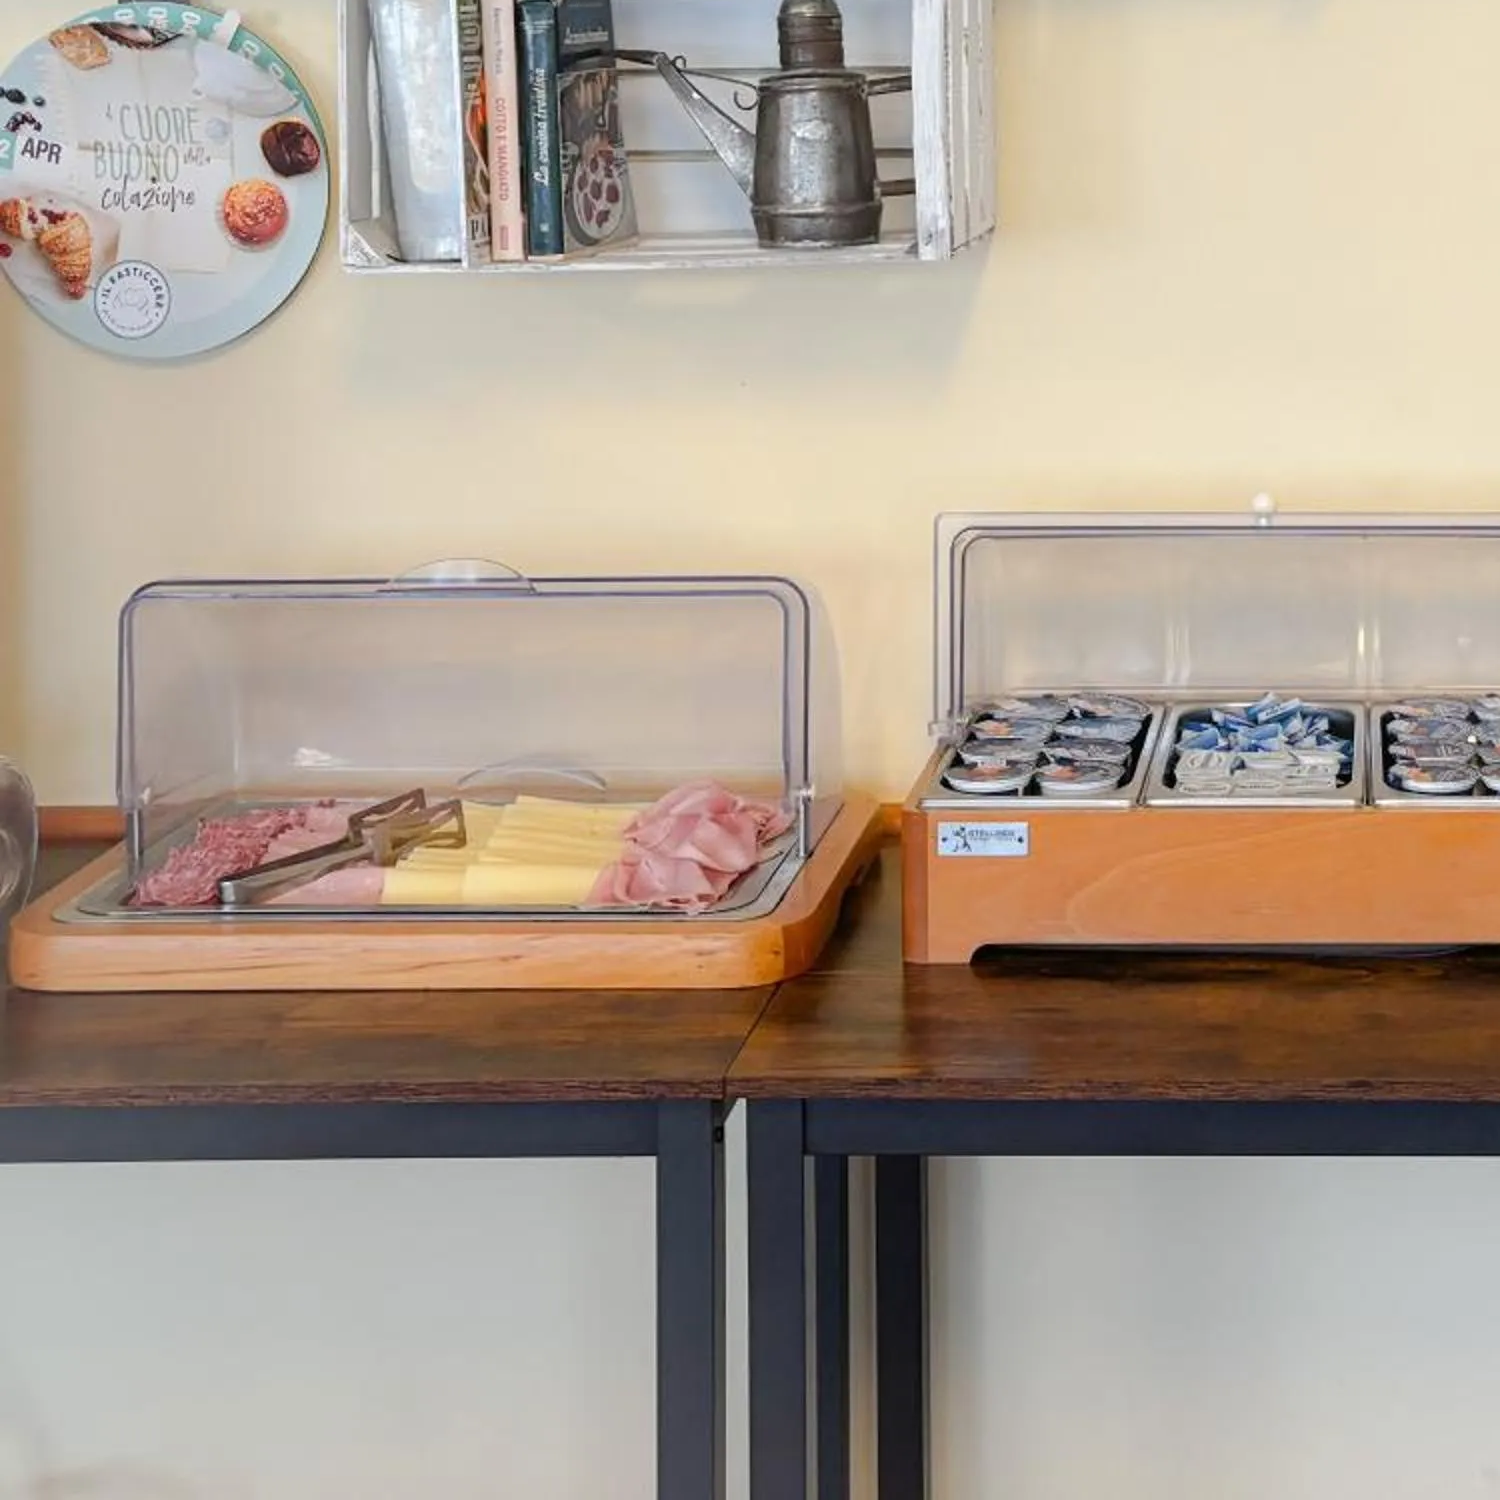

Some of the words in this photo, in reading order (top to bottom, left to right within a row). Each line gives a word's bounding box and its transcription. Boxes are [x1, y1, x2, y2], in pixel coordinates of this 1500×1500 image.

[120, 102, 201, 144] CUORE
[495, 97, 506, 132] COTTO
[21, 137, 62, 164] APR
[93, 140, 179, 182] BUONO
